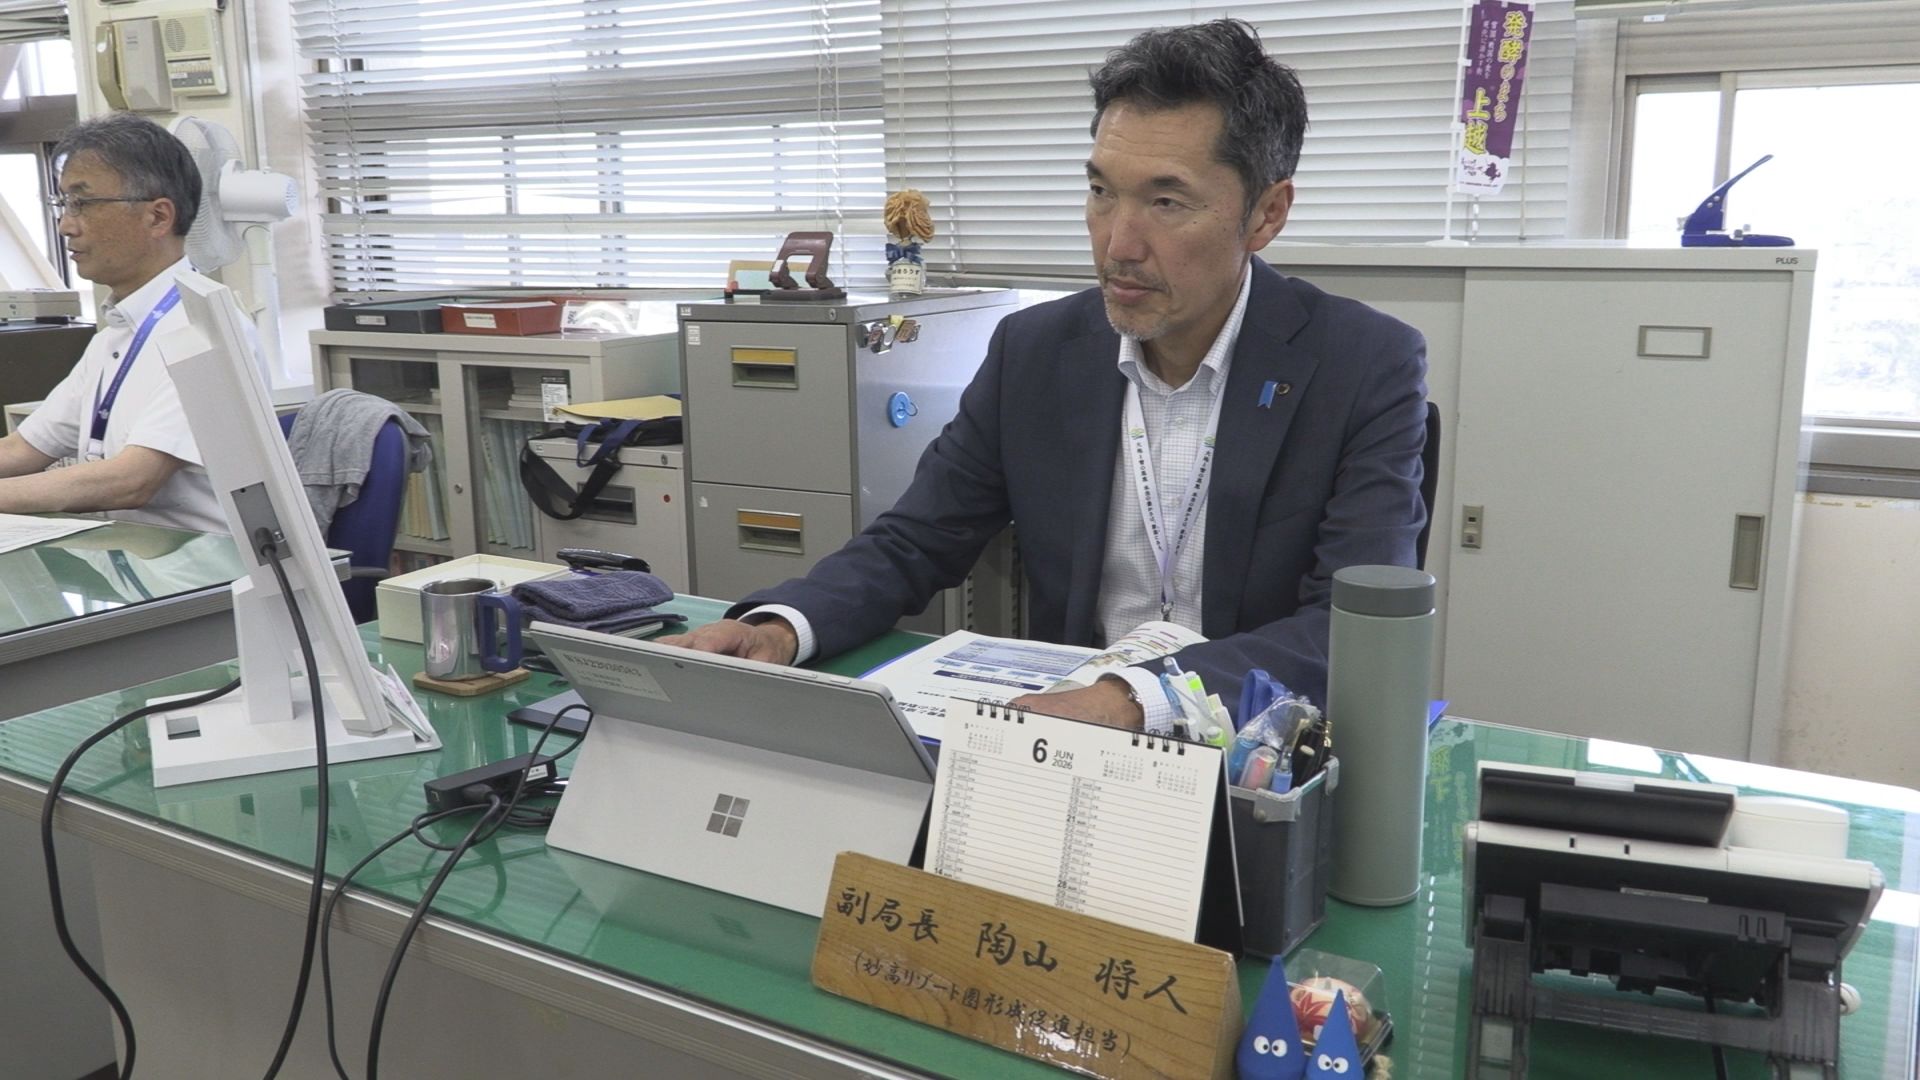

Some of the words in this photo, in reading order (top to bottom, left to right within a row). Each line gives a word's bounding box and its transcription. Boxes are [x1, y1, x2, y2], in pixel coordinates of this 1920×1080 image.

[1464, 87, 1491, 155] 上越
[1032, 738, 1049, 763] 6
[1053, 750, 1074, 760] JUN
[836, 887, 940, 945] 副局長
[975, 921, 1058, 972] 陶山
[1095, 957, 1188, 1016] 将人
